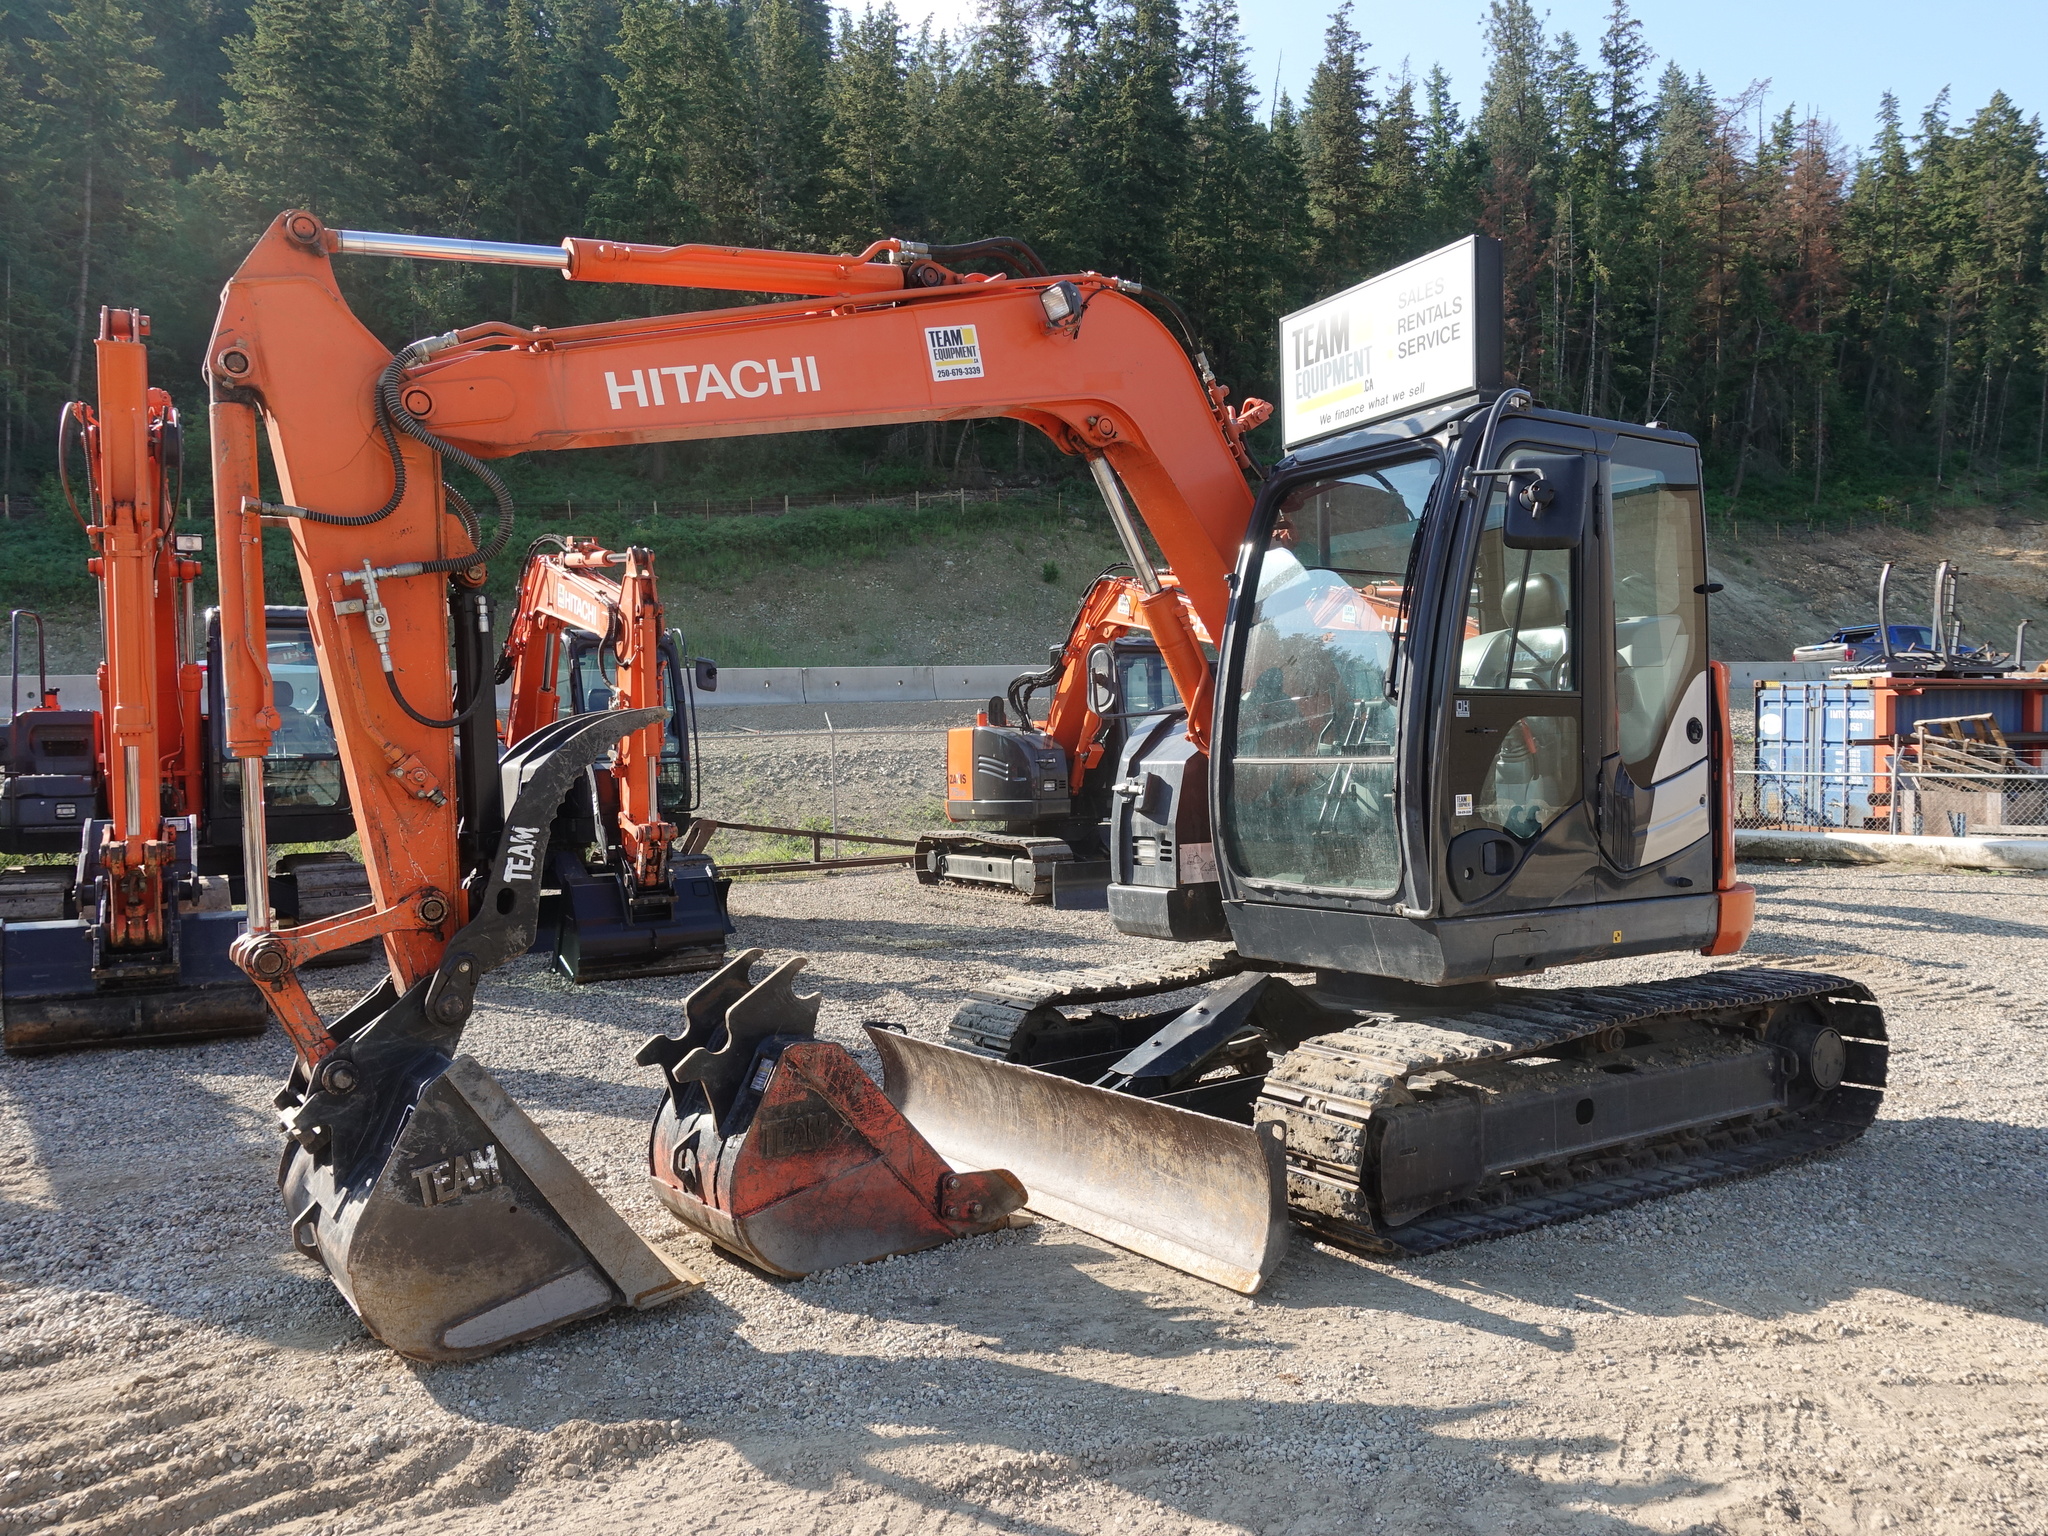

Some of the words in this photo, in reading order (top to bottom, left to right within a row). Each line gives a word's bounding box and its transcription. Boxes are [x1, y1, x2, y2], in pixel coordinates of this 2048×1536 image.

[1398, 277, 1445, 310] SALES
[1397, 296, 1463, 335] RENTALS
[928, 329, 963, 348] TEAM
[933, 345, 977, 361] EQUIPMENT
[1292, 309, 1350, 371] TEAM
[1397, 321, 1461, 359] SERVICE
[604, 355, 821, 410] HITACHI
[937, 366, 981, 378] 250-679-3339
[1295, 345, 1373, 400] EQUIPMENT
[1319, 412, 1332, 426] We
[1334, 403, 1365, 421] finance
[1368, 393, 1389, 410] what
[1392, 390, 1405, 402] we
[1408, 381, 1426, 398] sell
[565, 590, 597, 626] HITACHI
[503, 826, 540, 883] TEAM
[761, 1113, 828, 1159] TEAM
[410, 1144, 503, 1208] TEAM
